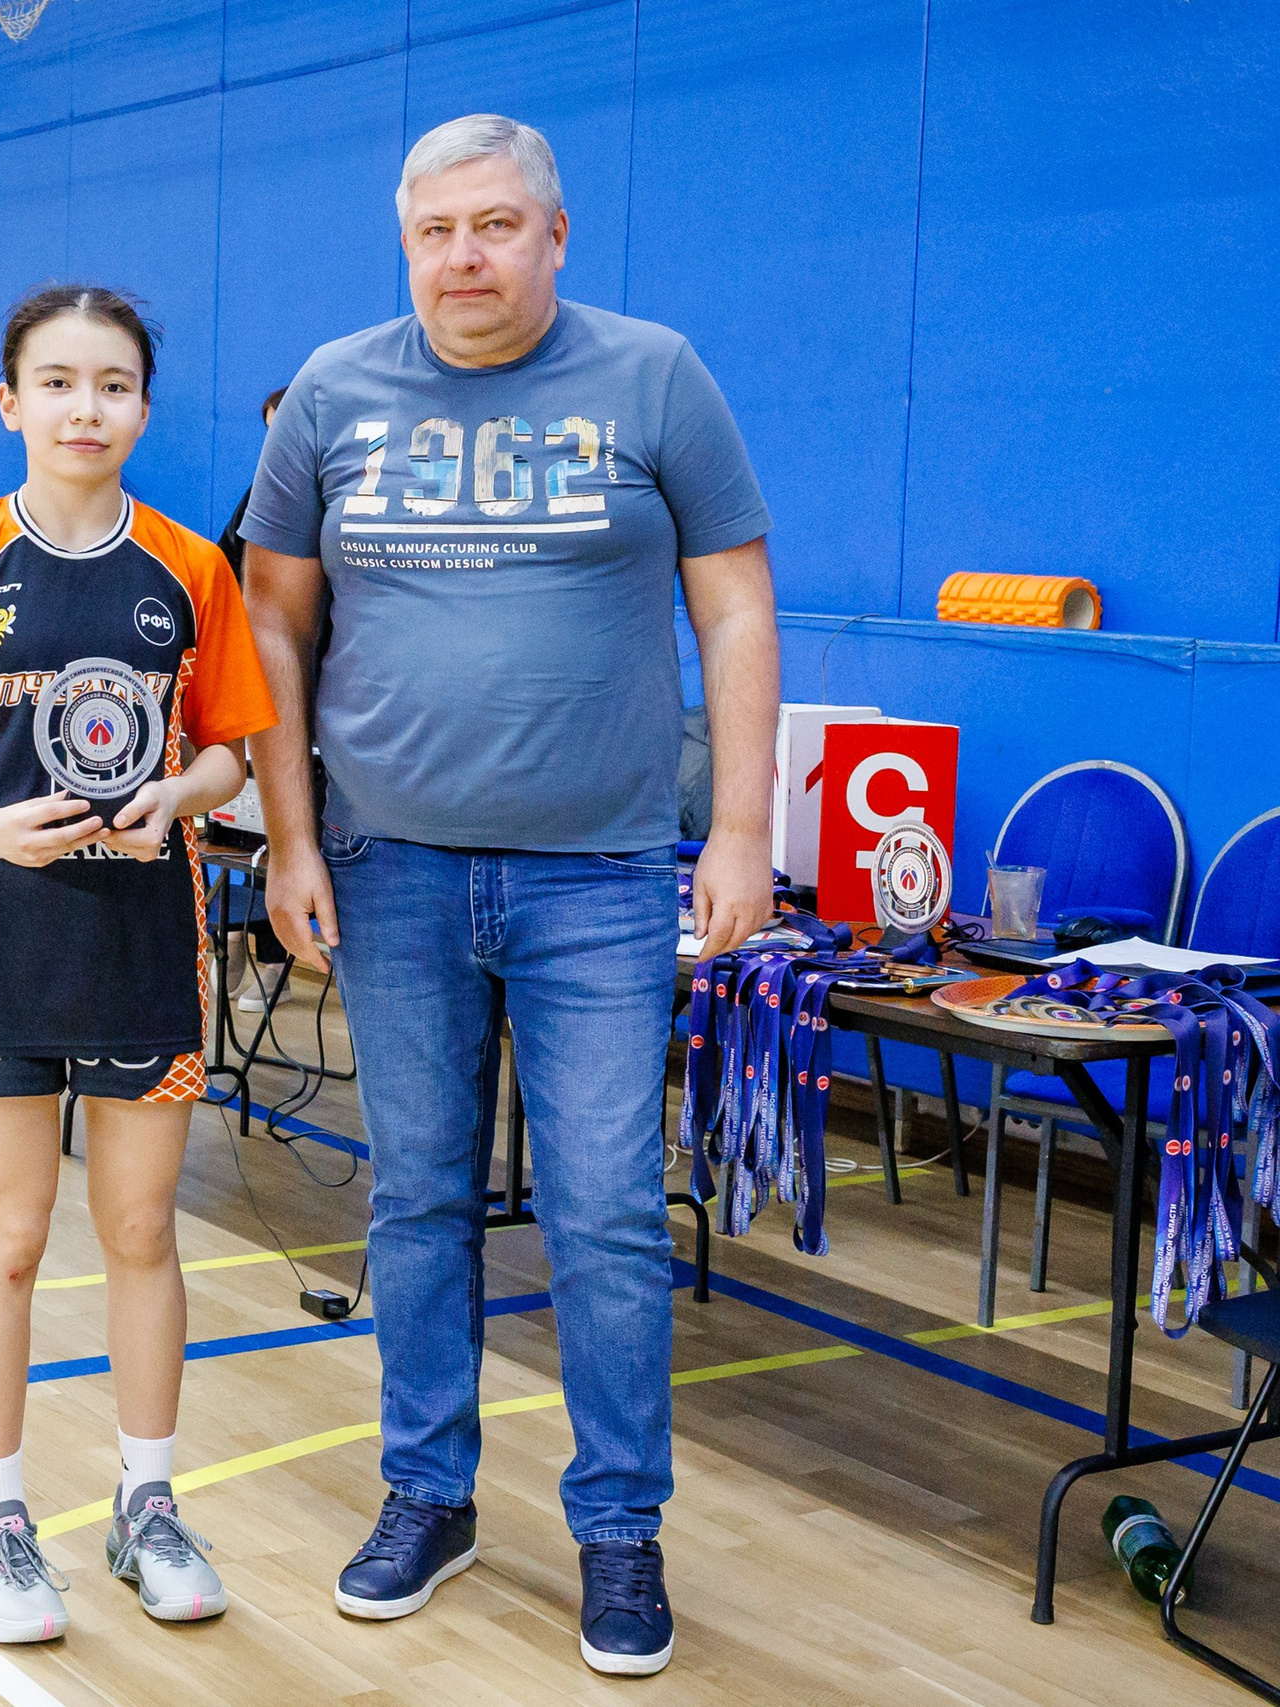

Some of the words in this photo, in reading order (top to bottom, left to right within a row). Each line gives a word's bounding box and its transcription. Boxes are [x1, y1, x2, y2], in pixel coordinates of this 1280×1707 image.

[605, 419, 616, 445] TOM
[343, 415, 607, 517] 1962
[340, 541, 382, 554] CASUAL
[385, 542, 500, 554] MANUFACTURING
[503, 542, 538, 554] CLUB
[344, 556, 388, 568] CLASSIC
[389, 558, 441, 569] CUSTOM
[444, 557, 494, 569] DESIGN
[139, 613, 172, 630] РФБ
[1168, 1203, 1177, 1238] ОБЛАСТИ
